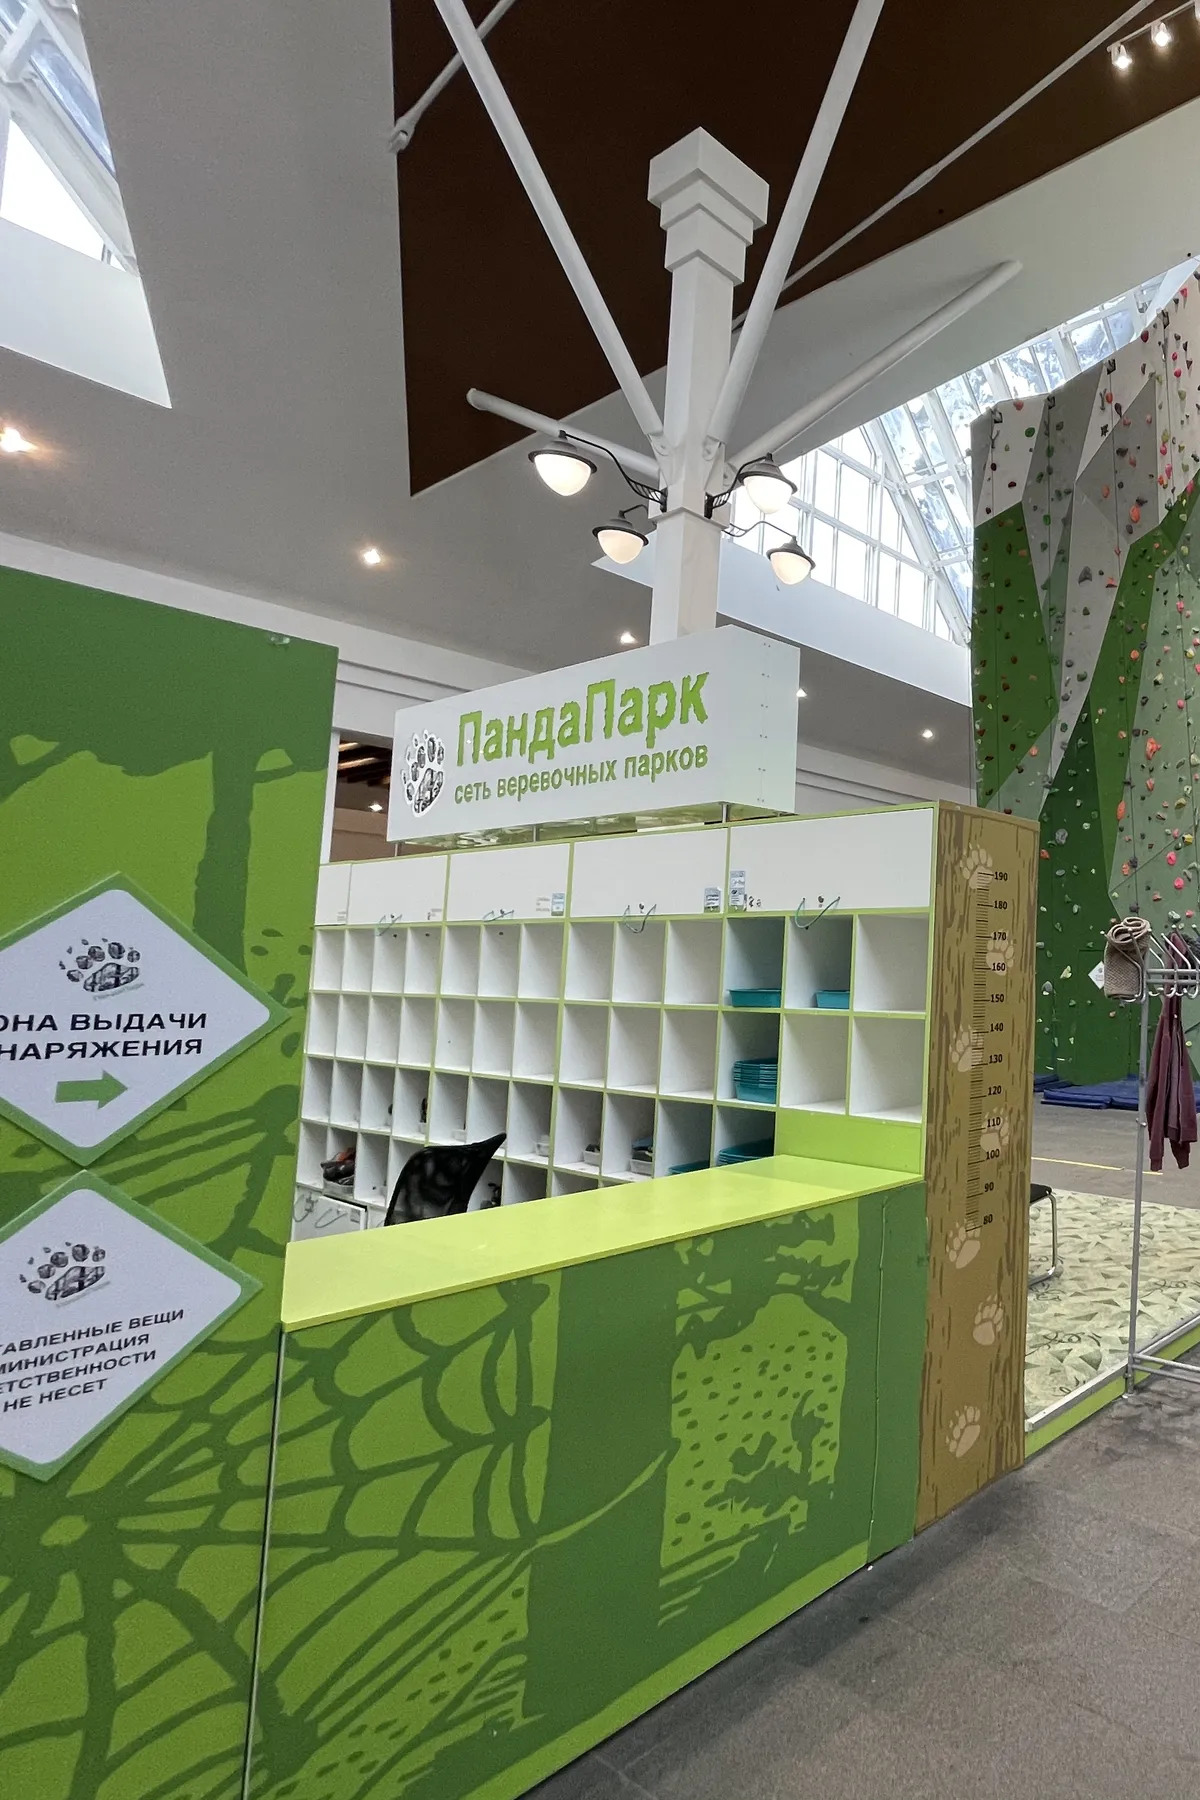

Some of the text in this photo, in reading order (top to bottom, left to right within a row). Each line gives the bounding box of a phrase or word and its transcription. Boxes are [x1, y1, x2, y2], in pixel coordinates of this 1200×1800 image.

[457, 672, 709, 767] ПандаПарк
[454, 744, 708, 804] сеть веревочных парков
[994, 871, 1008, 881] 190
[993, 901, 1008, 910] 180
[992, 932, 1007, 941] 170
[992, 963, 1006, 971] 160
[990, 994, 1005, 1003] 150
[70, 1013, 207, 1033] ВЫДАЧИ
[990, 1023, 1004, 1032] 140
[0, 1038, 203, 1061] НАРЯЖЕНИЯ
[989, 1054, 1003, 1064] 130
[988, 1085, 1002, 1096] 120
[987, 1117, 1001, 1128] 110
[986, 1149, 1000, 1160] 100
[984, 1182, 994, 1192] 90
[983, 1214, 993, 1225] 80
[0, 1309, 184, 1355] АВЛЕННЫЕ ВЕЩИ
[3, 1378, 108, 1413] НЕ НЕСЕТ
